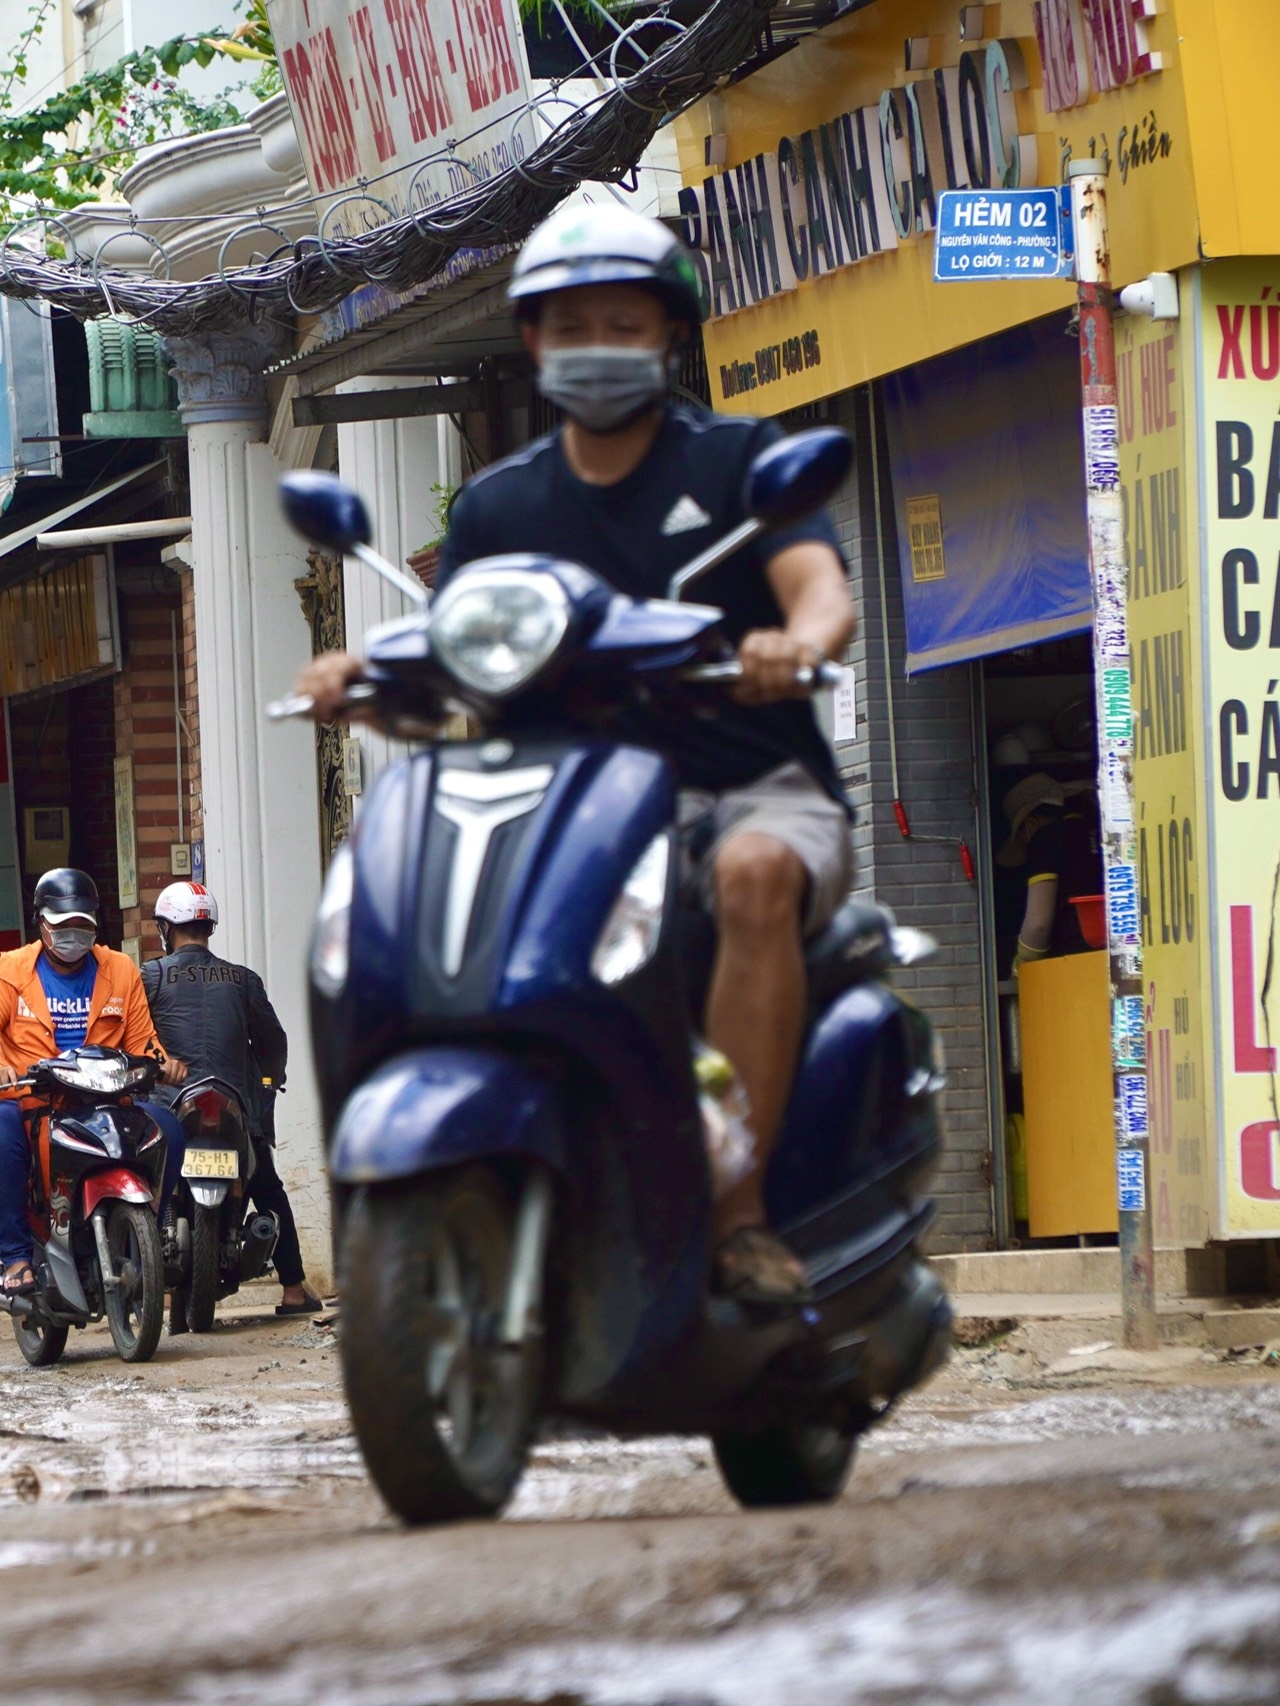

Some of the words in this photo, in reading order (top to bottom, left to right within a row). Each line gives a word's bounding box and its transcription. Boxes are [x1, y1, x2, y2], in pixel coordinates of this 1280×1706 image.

[778, 107, 890, 282] CANH
[954, 197, 1012, 227] HẺM
[1019, 202, 1047, 227] 02
[973, 233, 988, 246] VĂN
[989, 234, 1012, 246] CÔNG
[1017, 234, 1050, 247] PHƯỜNG
[1051, 236, 1057, 247] 3
[973, 249, 1002, 268] GIỚI
[1014, 256, 1030, 268] 12
[1032, 256, 1045, 268] M
[1130, 630, 1187, 761] ANH
[194, 844, 202, 866] 8
[1158, 796, 1194, 945] LÓC
[191, 1151, 229, 1163] 75-H1
[185, 1164, 235, 1176] 367.64
